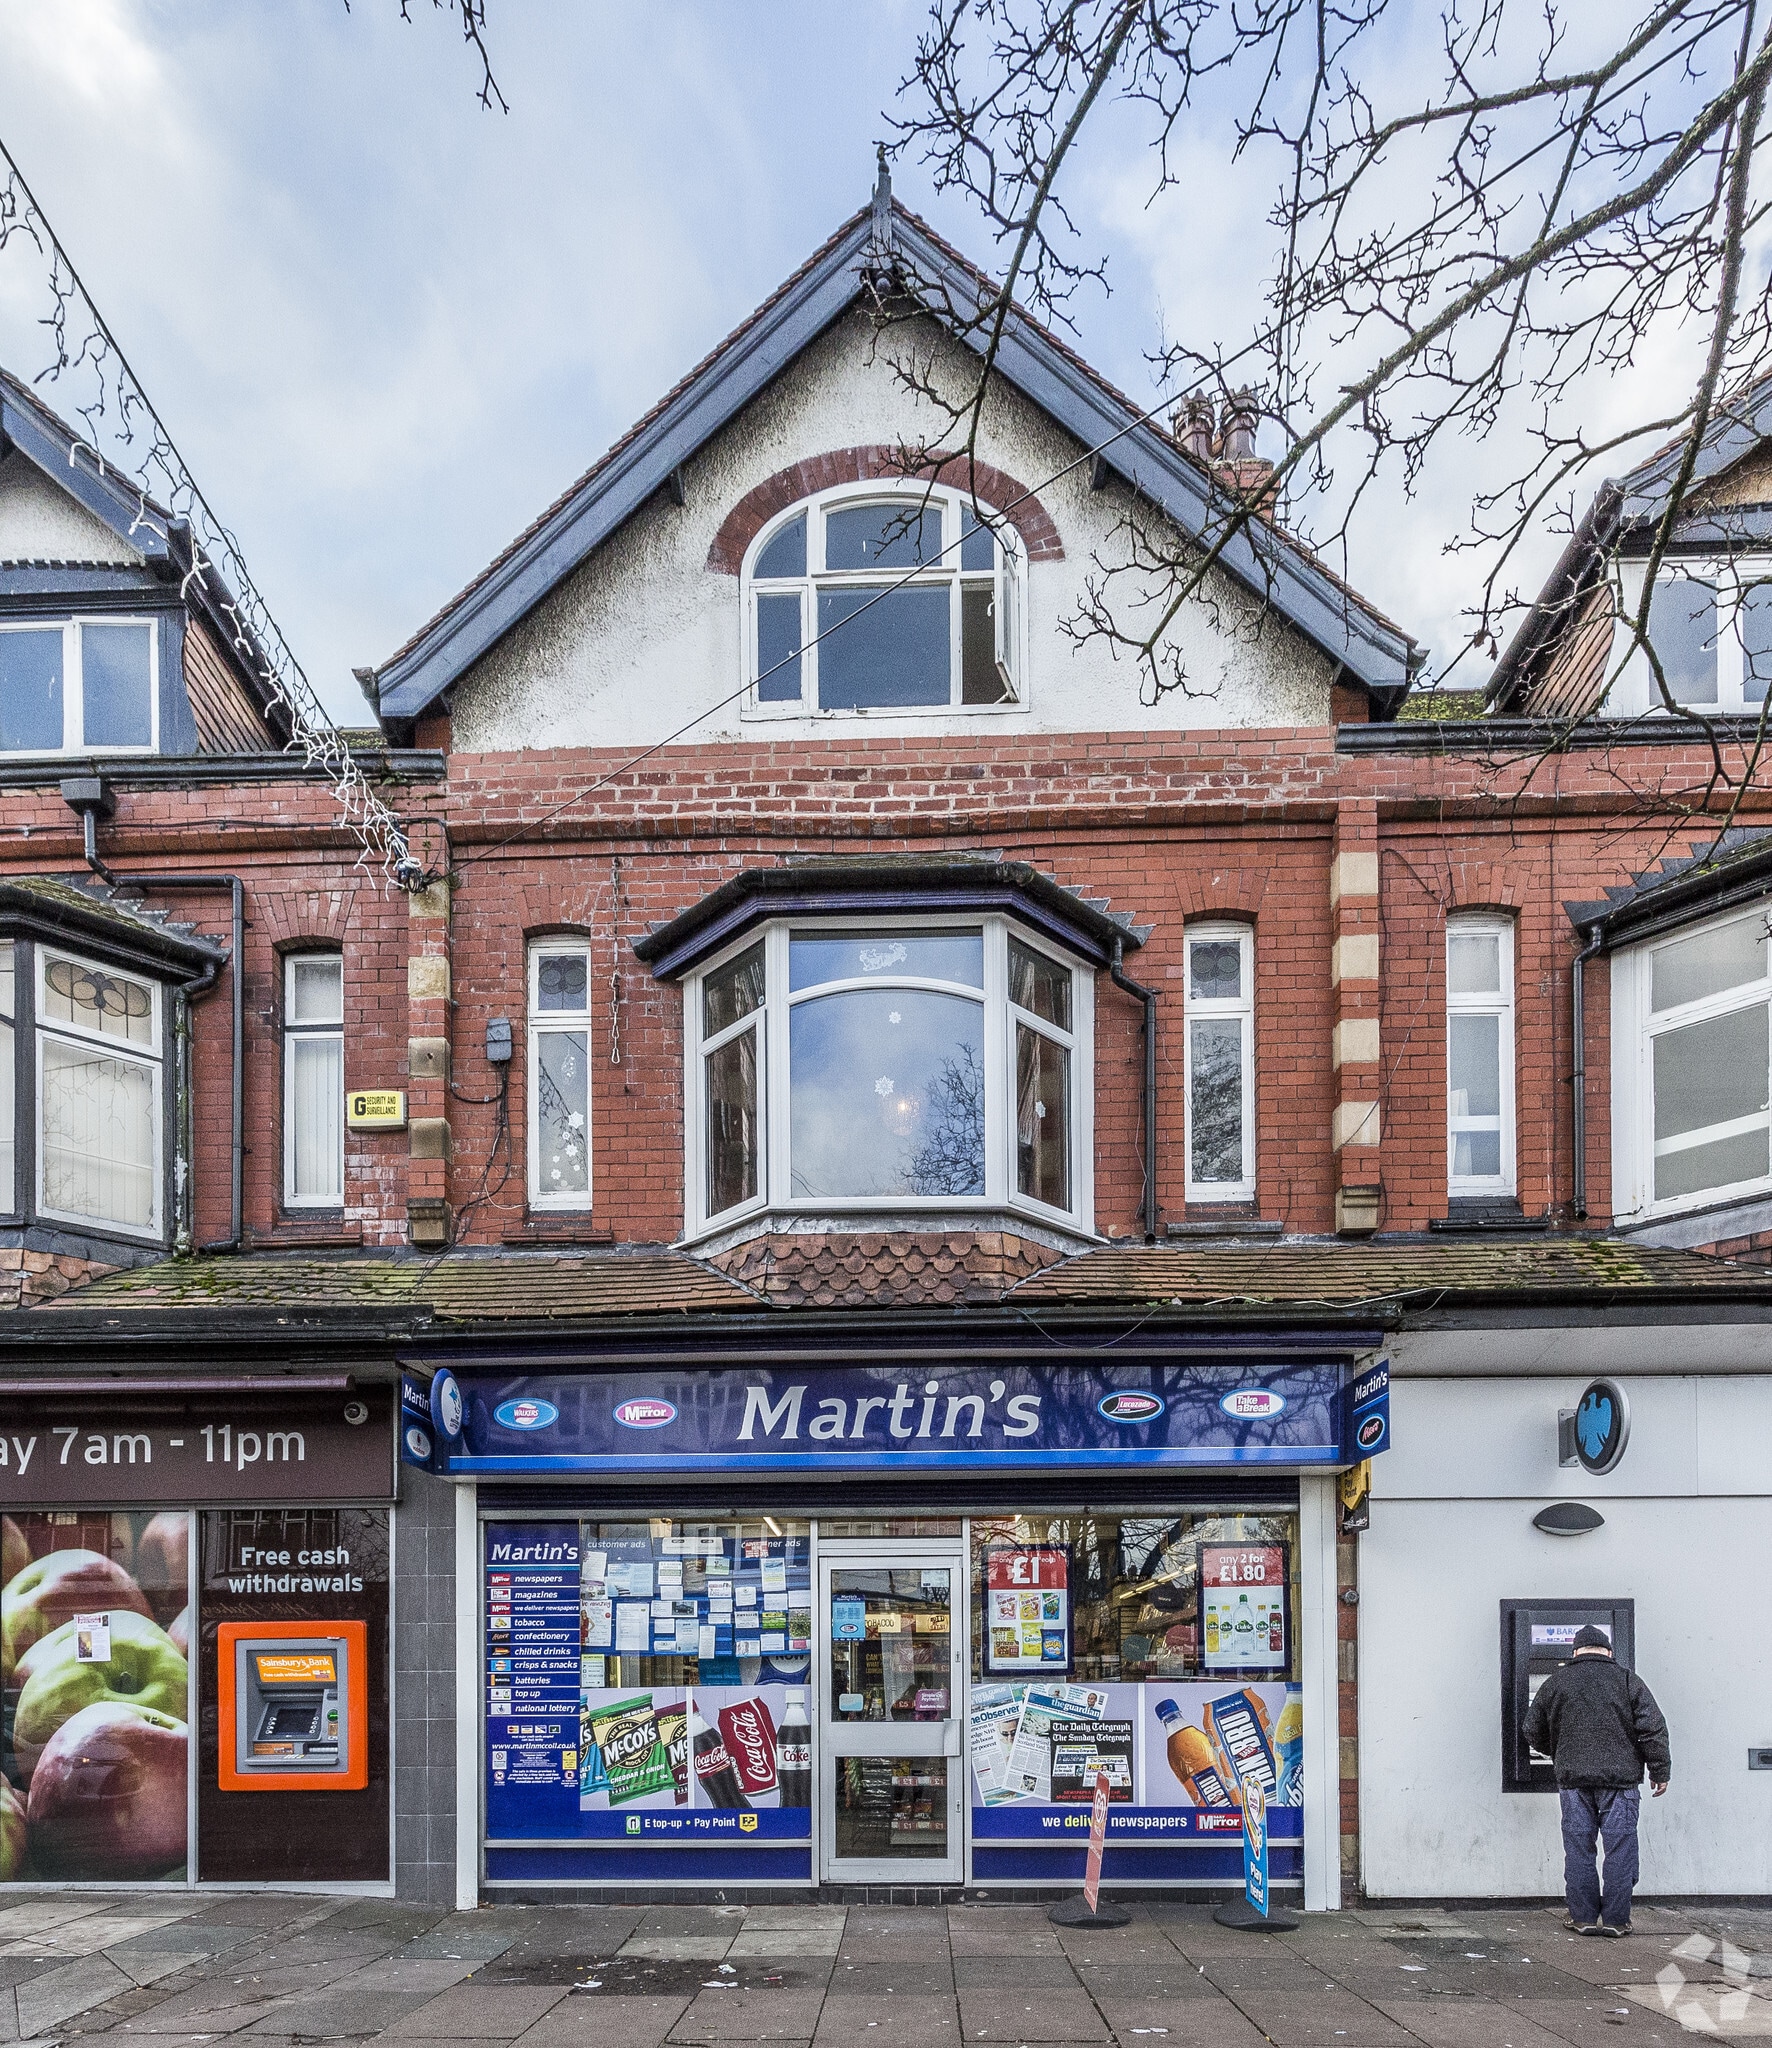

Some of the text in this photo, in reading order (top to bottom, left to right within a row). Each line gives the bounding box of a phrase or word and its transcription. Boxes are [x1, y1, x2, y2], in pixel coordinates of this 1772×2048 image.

[367, 1096, 396, 1105] SECURITY AND
[355, 1096, 366, 1116] G
[367, 1106, 396, 1115] SURVEILLANCE
[1355, 1371, 1388, 1402] Martin's
[404, 1384, 429, 1411] Martin
[1237, 1395, 1258, 1405] Take
[736, 1379, 1042, 1440] Martin's
[1243, 1403, 1270, 1412] Break
[625, 1406, 666, 1420] Mirror
[52, 1427, 152, 1464] 7am
[200, 1424, 306, 1471] 11pm
[587, 1540, 646, 1548] customer ads
[785, 1539, 801, 1547] ads
[241, 1546, 350, 1566] Free cash
[491, 1543, 578, 1560] Martin's
[1220, 1554, 1265, 1565] any 2 for
[1012, 1556, 1040, 1584] £1
[1220, 1565, 1265, 1582] £1.80
[229, 1574, 363, 1593] withdrawals
[514, 1575, 563, 1584] newspapers
[514, 1591, 558, 1600] magazines
[514, 1618, 545, 1626] tobacco
[514, 1632, 570, 1641] confectionery
[515, 1647, 571, 1655] chilled drinks
[260, 1658, 330, 1667] Sainsbury's Bank
[515, 1661, 539, 1670] crisps
[515, 1676, 551, 1684] batteries
[515, 1690, 528, 1698] top
[515, 1704, 576, 1713] national lottery
[1052, 1722, 1131, 1733] The Daily Telegraph
[1052, 1733, 1068, 1742] The
[1068, 1734, 1096, 1743] Sunday
[1096, 1734, 1131, 1743] Telegraph
[784, 1750, 809, 1762] Coke
[610, 1772, 638, 1784] CHEDDAR
[646, 1764, 665, 1773] ONION
[645, 1819, 682, 1829] E top-up
[694, 1818, 735, 1829] Pay Point
[1042, 1815, 1188, 1829] we deliv newspapers
[1199, 1815, 1239, 1829] Mirror
